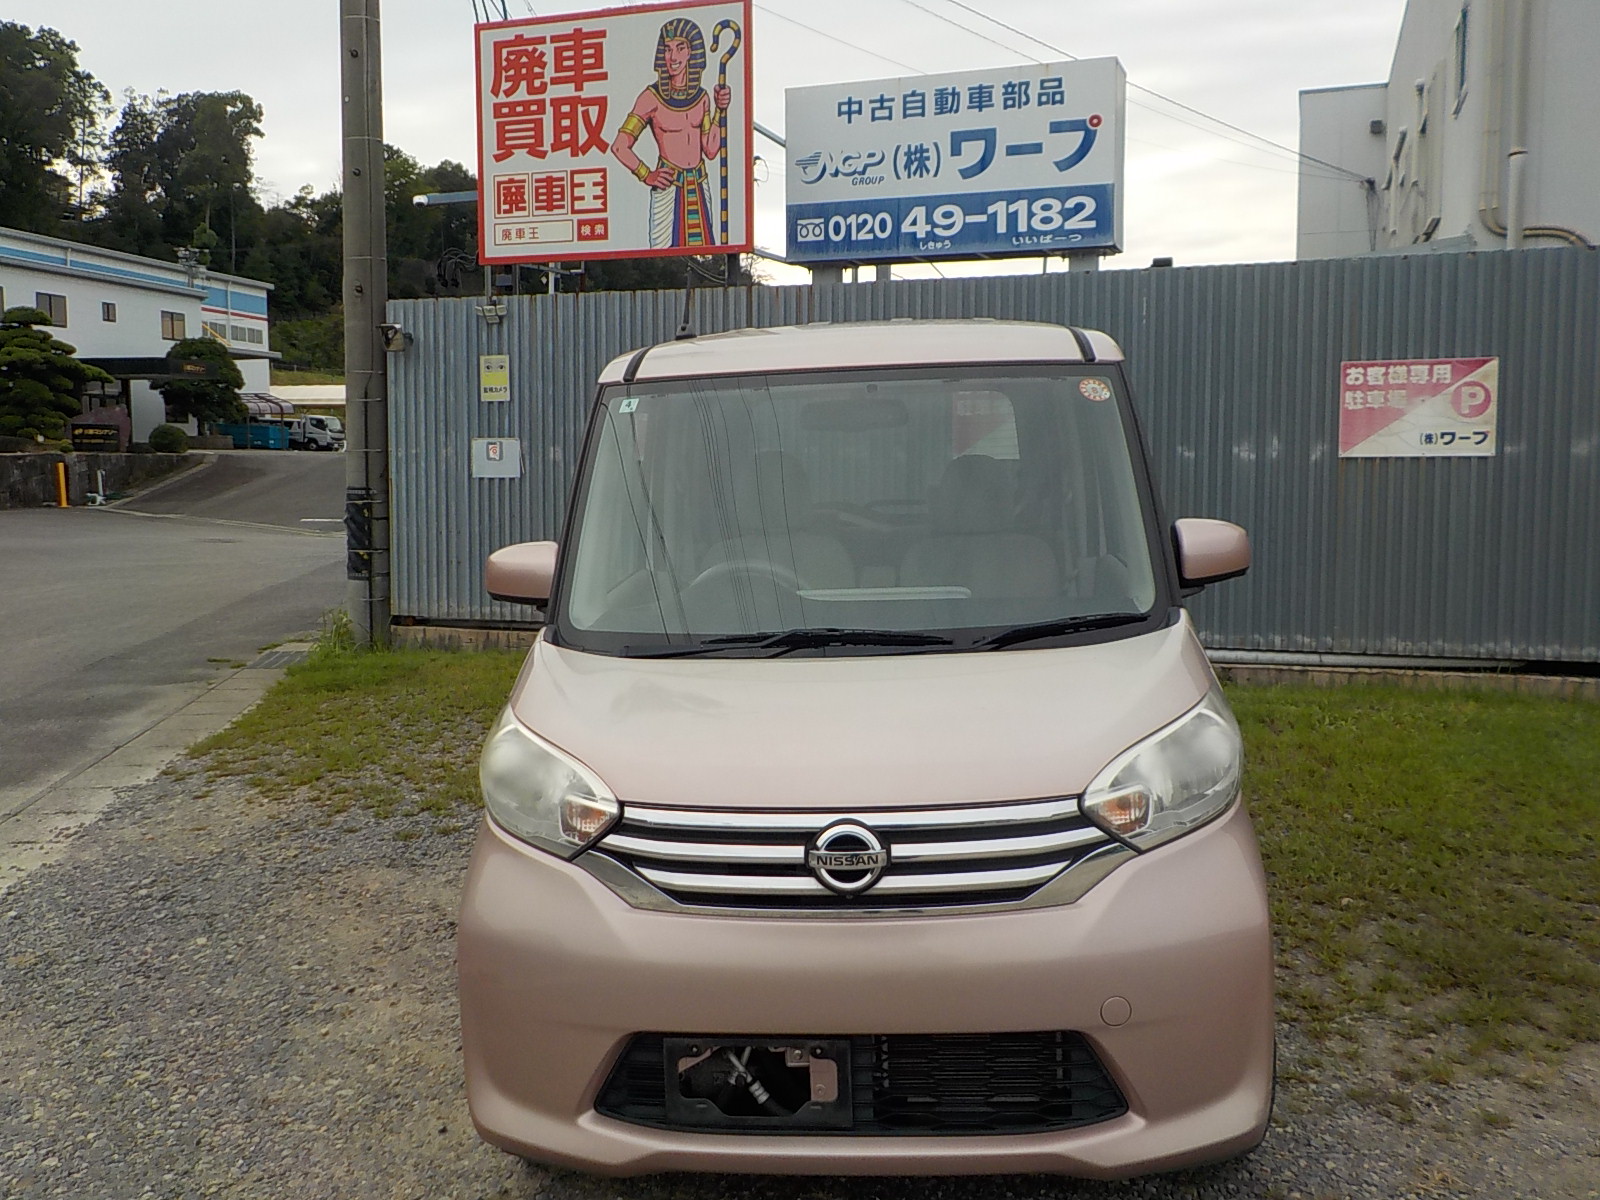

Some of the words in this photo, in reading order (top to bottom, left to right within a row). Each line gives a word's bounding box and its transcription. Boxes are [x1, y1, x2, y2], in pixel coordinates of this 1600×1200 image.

[490, 28, 608, 98] 廃車
[837, 76, 1066, 124] 中古自動車部品
[492, 95, 611, 163] 買取
[494, 167, 608, 219] 廃車王
[851, 176, 885, 186] GROUP
[580, 224, 605, 236] 検索
[828, 212, 892, 241] 0120
[901, 196, 1097, 238] 49-1182
[501, 226, 540, 241] 廃車王
[1345, 364, 1451, 386] お客様専用
[1461, 386, 1486, 414] P
[816, 854, 879, 867] NISSAN
